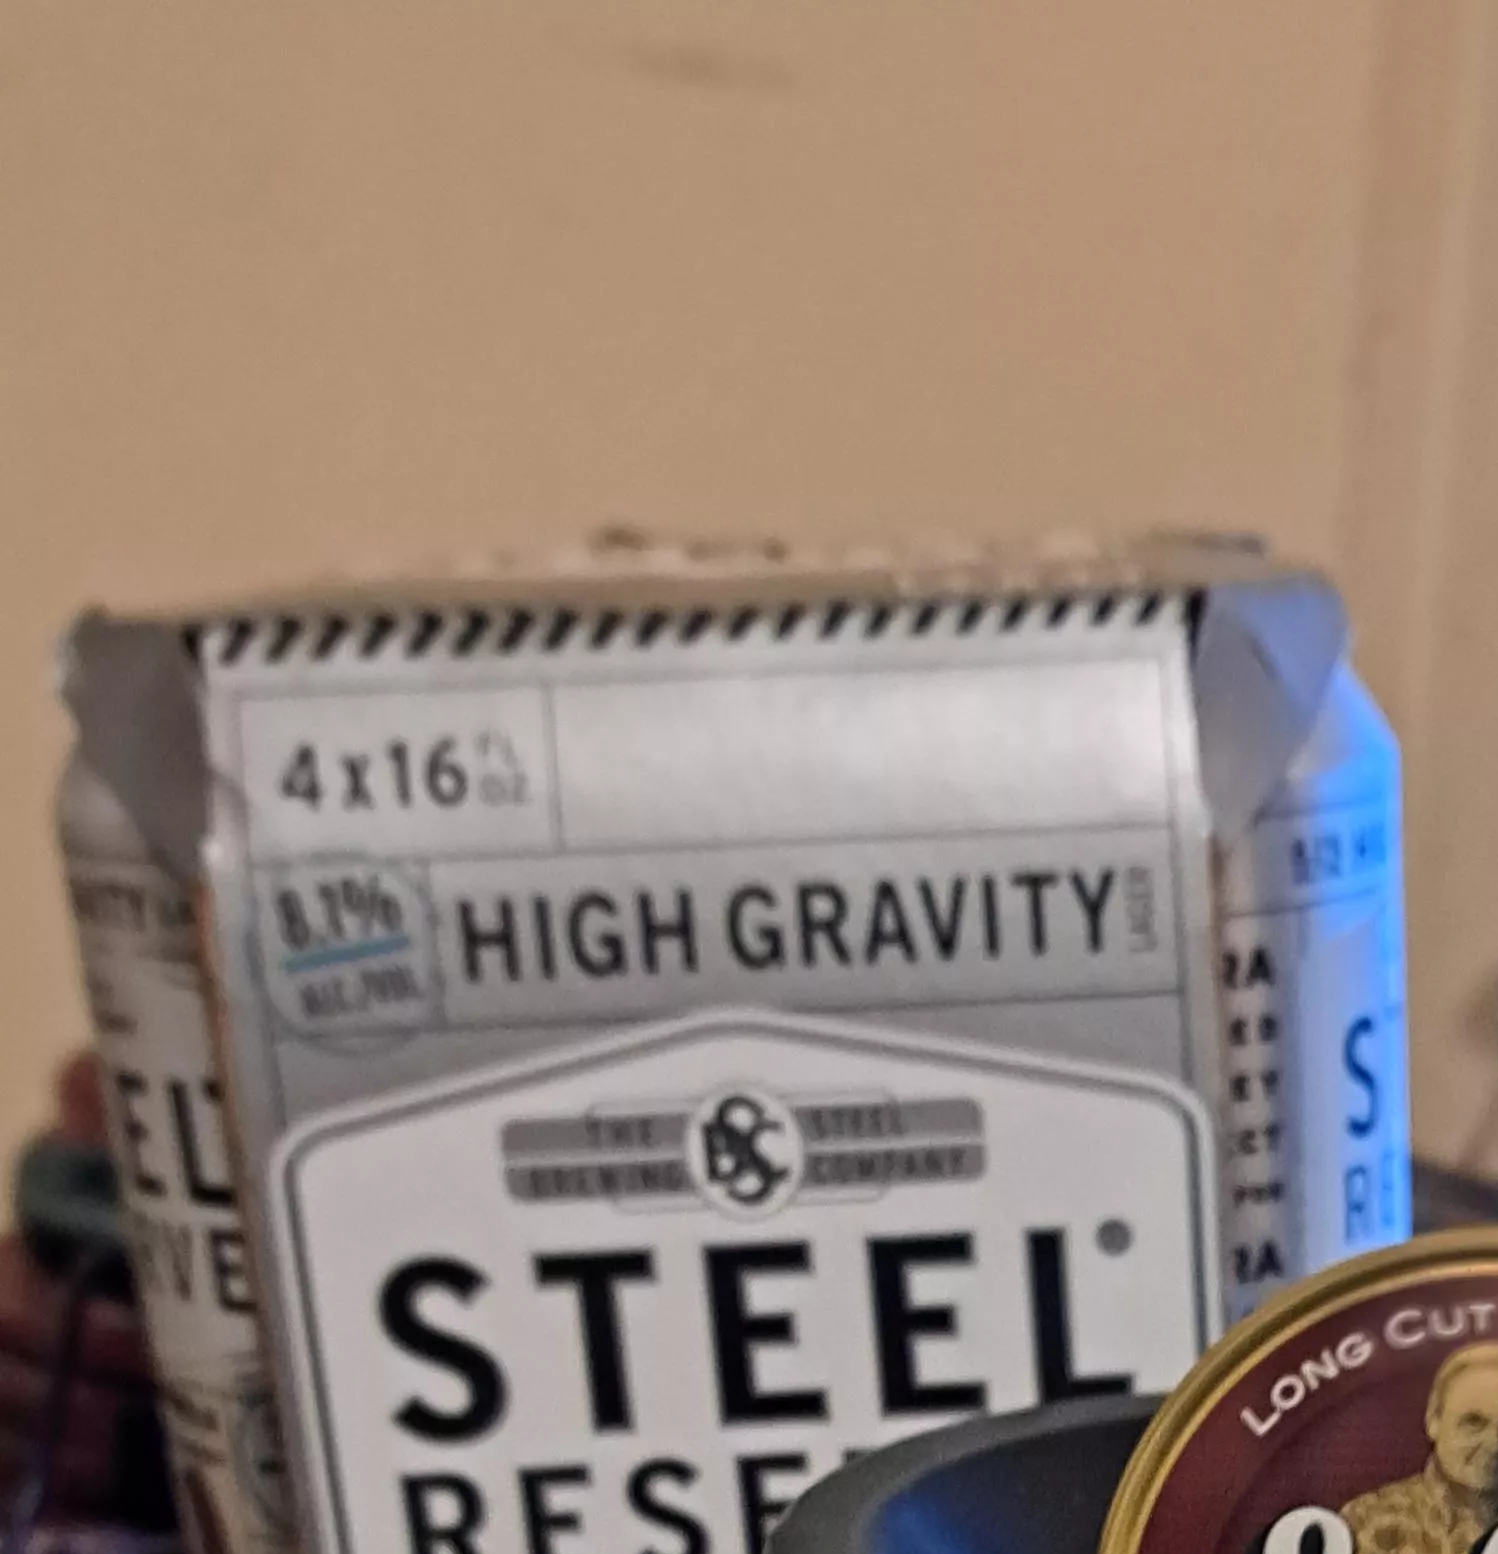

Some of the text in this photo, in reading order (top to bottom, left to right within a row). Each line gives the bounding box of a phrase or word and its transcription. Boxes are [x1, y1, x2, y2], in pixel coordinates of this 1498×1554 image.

[458, 866, 1117, 985] HIGH GRAVITY
[377, 1227, 1133, 1446] STEEL
[1239, 1326, 1378, 1439] LONG
[1384, 1297, 1496, 1351] CUT
